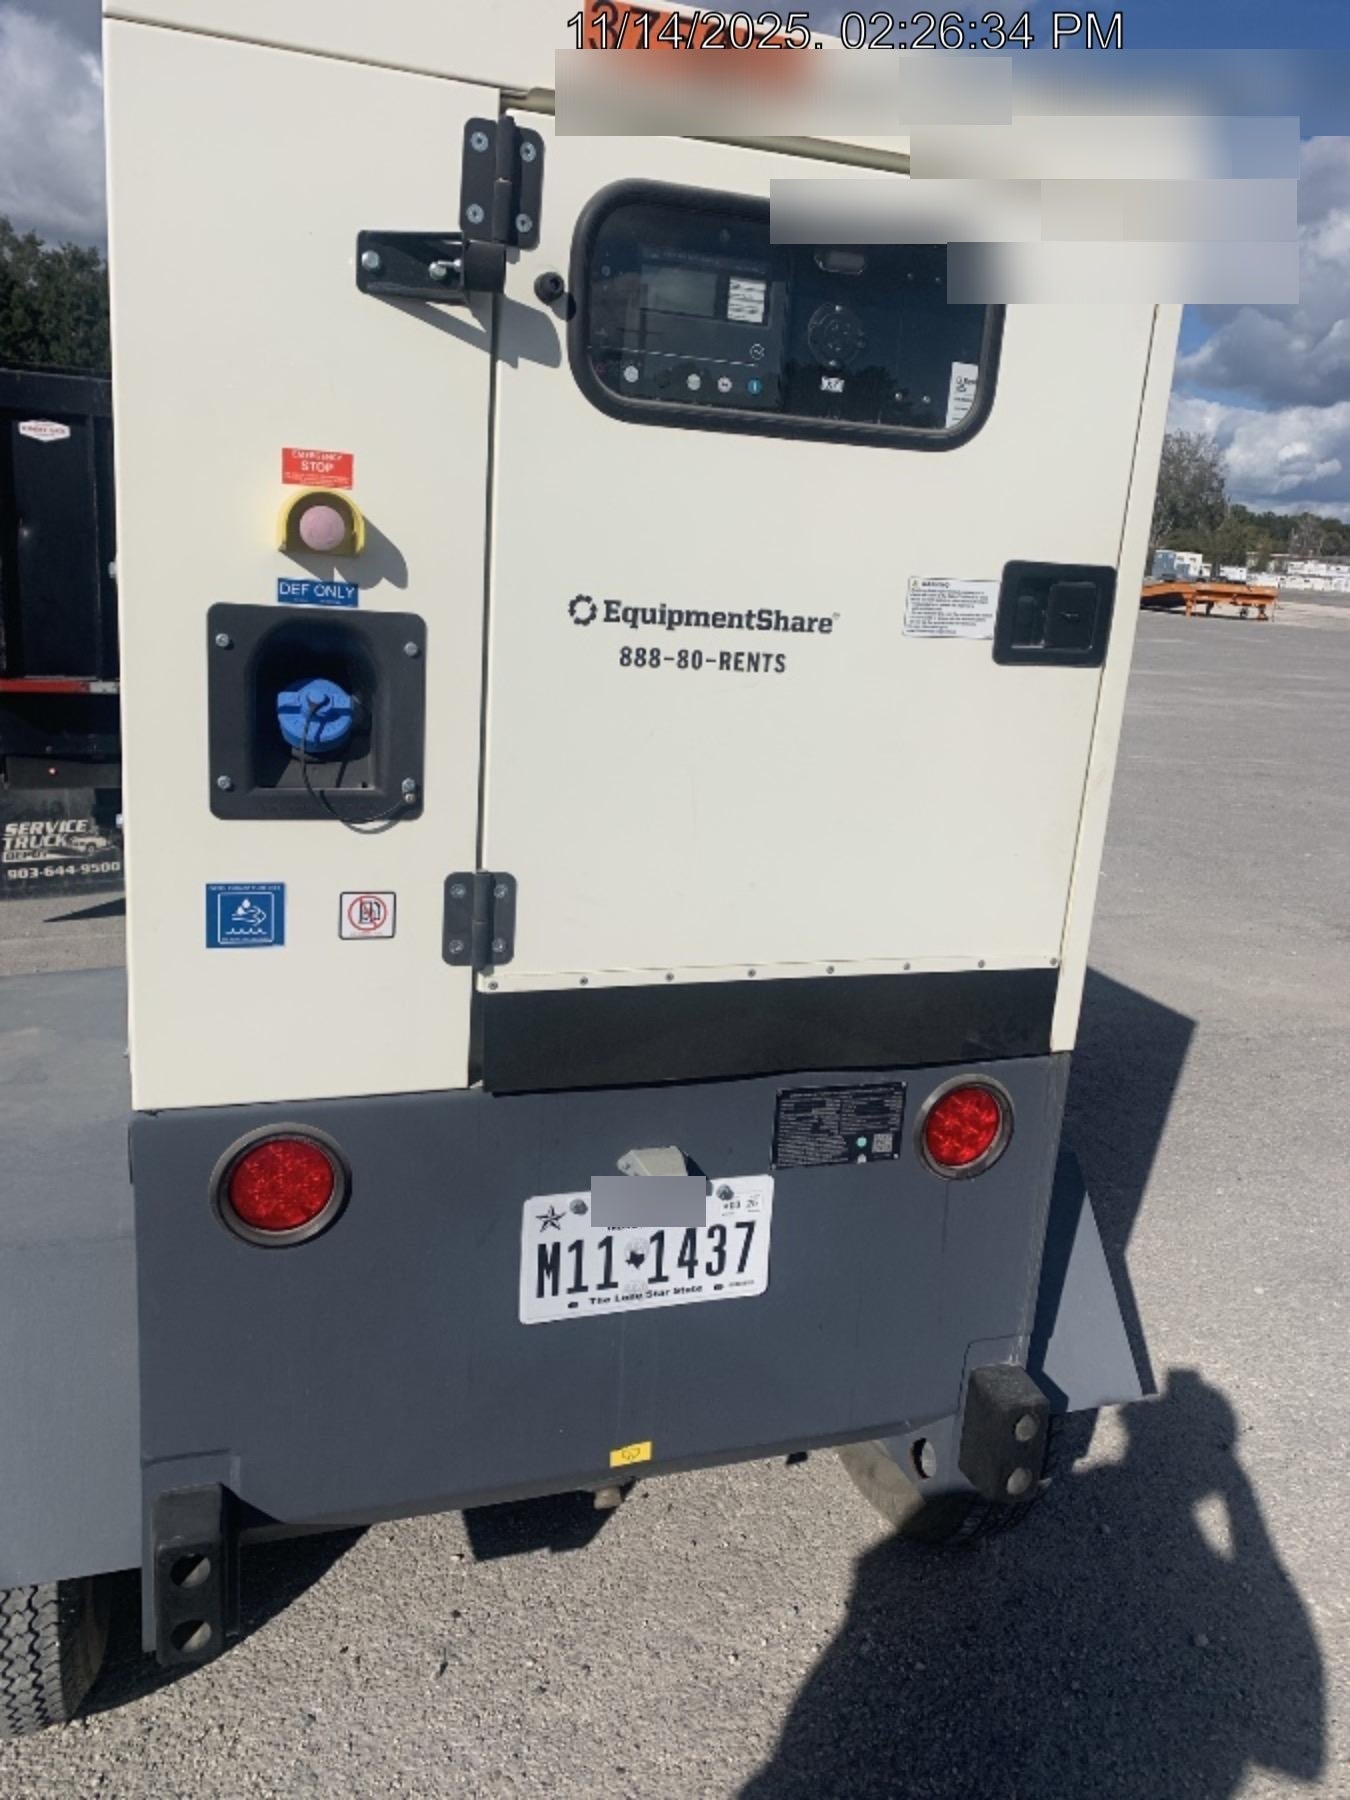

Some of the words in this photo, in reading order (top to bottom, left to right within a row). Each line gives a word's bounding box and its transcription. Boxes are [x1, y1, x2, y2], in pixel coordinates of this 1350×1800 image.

[301, 460, 335, 473] STOP
[279, 583, 311, 596] DEF
[313, 584, 356, 599] ONLY
[603, 600, 834, 634] EquipmentShare
[619, 646, 787, 673] 888-80-RENTS
[4, 819, 88, 836] SERVICE
[3, 834, 67, 850] TRUCK
[7, 861, 120, 879] 903-644-9500
[536, 1235, 618, 1298] M11
[648, 1221, 756, 1284] 1437
